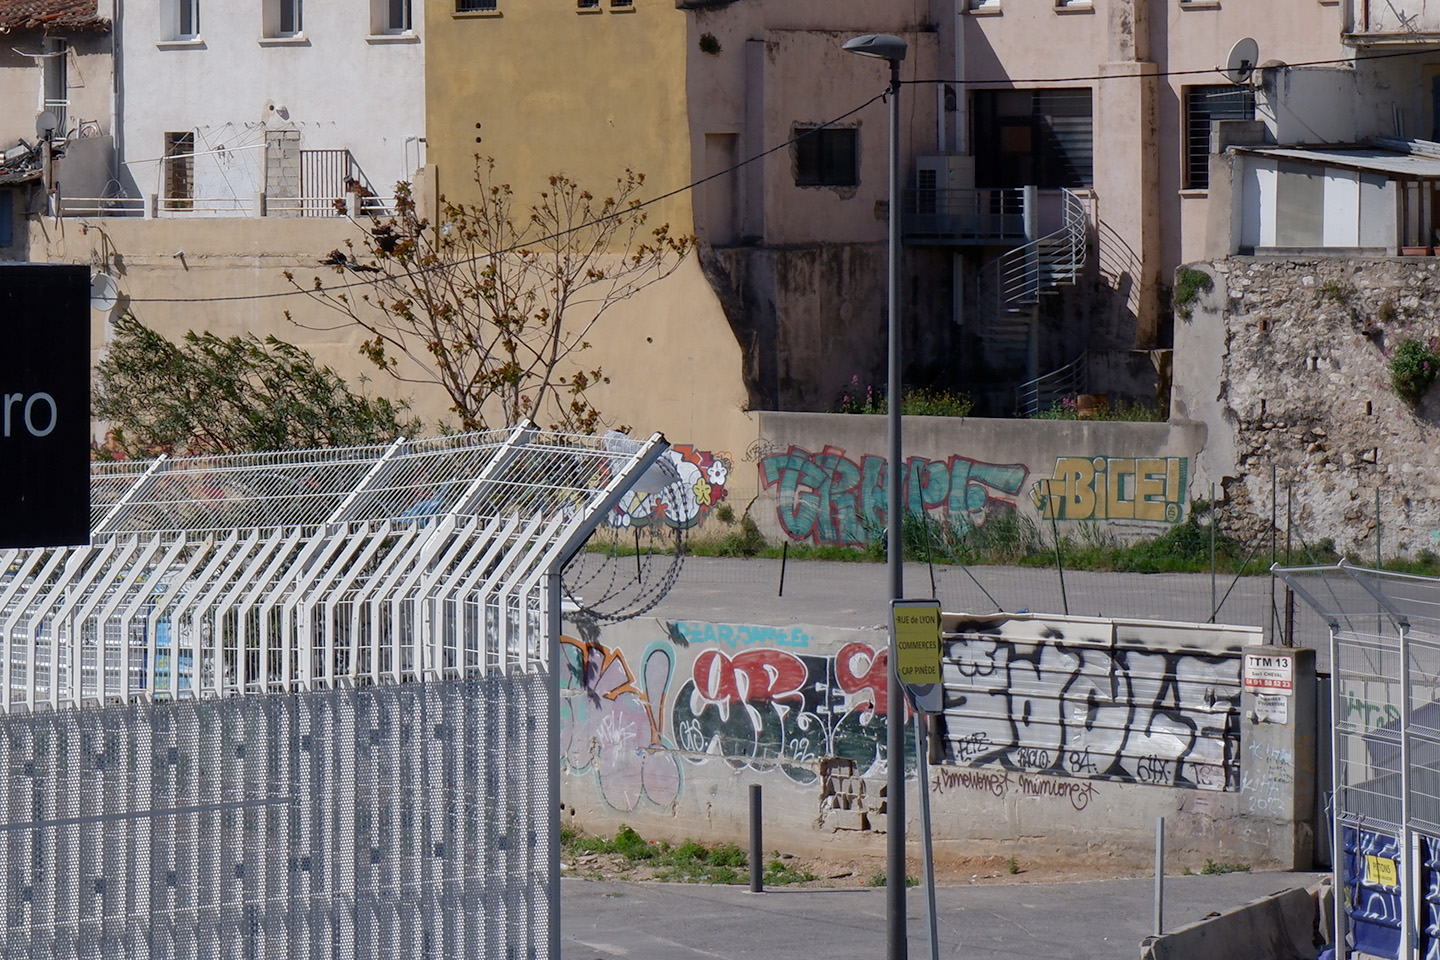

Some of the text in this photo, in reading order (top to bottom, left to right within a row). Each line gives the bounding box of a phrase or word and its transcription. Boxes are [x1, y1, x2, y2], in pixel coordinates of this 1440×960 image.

[897, 615, 936, 624] RUE de LYON
[898, 640, 937, 649] COMMERCES
[1249, 657, 1288, 668] TTM 13
[901, 664, 936, 675] CAP PINÈDE
